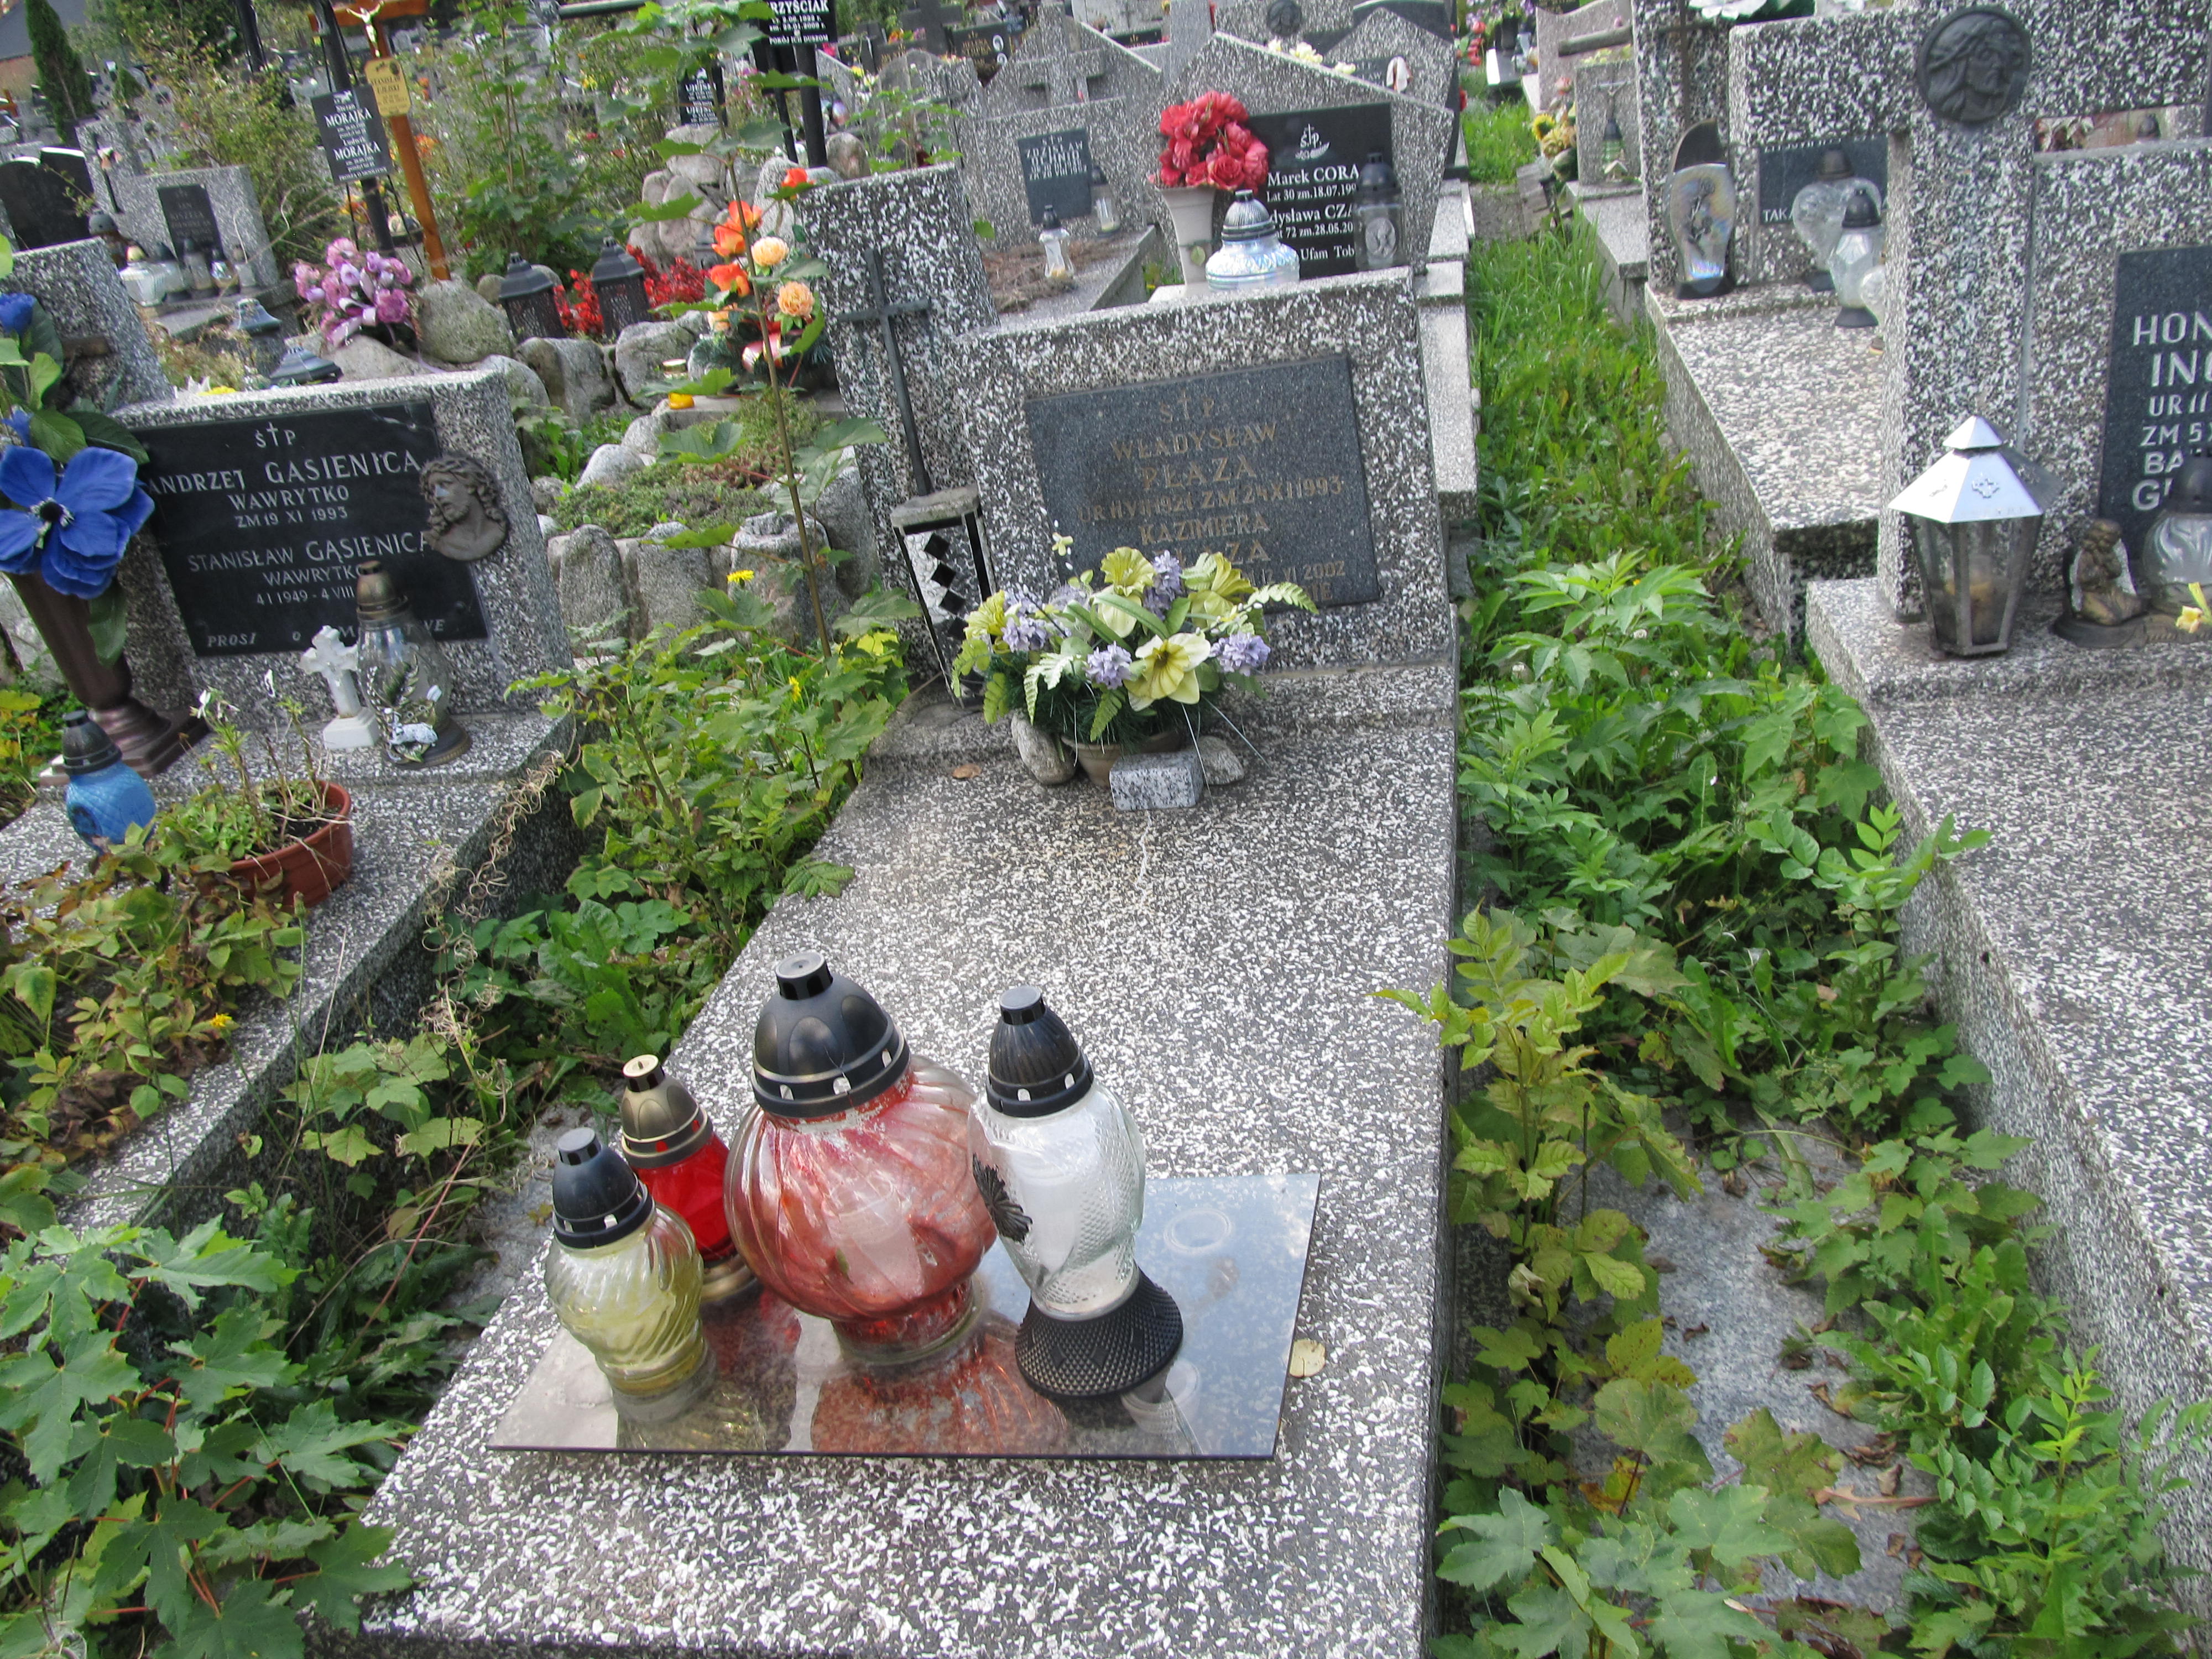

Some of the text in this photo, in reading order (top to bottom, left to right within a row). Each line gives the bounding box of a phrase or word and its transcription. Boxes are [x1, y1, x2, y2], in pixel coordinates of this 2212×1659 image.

[767, 0, 830, 15] RZYŚCIAK
[324, 107, 373, 127] MORAJKA
[333, 141, 382, 160] MORAJKA
[1267, 169, 1310, 187] Marek
[1266, 183, 1357, 203] Lat 30 zm.18.07.199
[1269, 208, 1321, 228] dysława
[1286, 226, 1297, 238] 72
[1299, 221, 1354, 237] zm.28.05.20
[1300, 244, 1355, 261] Ufam Tob
[2149, 394, 2183, 416] UR
[1110, 422, 1277, 461] WŁADYSŁAW
[2140, 424, 2180, 447] ZM
[2189, 421, 2203, 443] 5
[2143, 450, 2184, 475] BA
[1142, 454, 1256, 492] PŁAZA
[228, 484, 349, 512] WAWRYTKO
[1201, 487, 1237, 509] ZM
[1296, 474, 1342, 498] 1993
[235, 506, 348, 528] ZM 19 XI 1993
[1138, 512, 1271, 546] KAZIMIERA
[187, 546, 294, 573] STANISŁAW
[1303, 561, 1345, 580] 2002
[277, 588, 308, 604] 1949
[207, 631, 257, 648] PROSI
